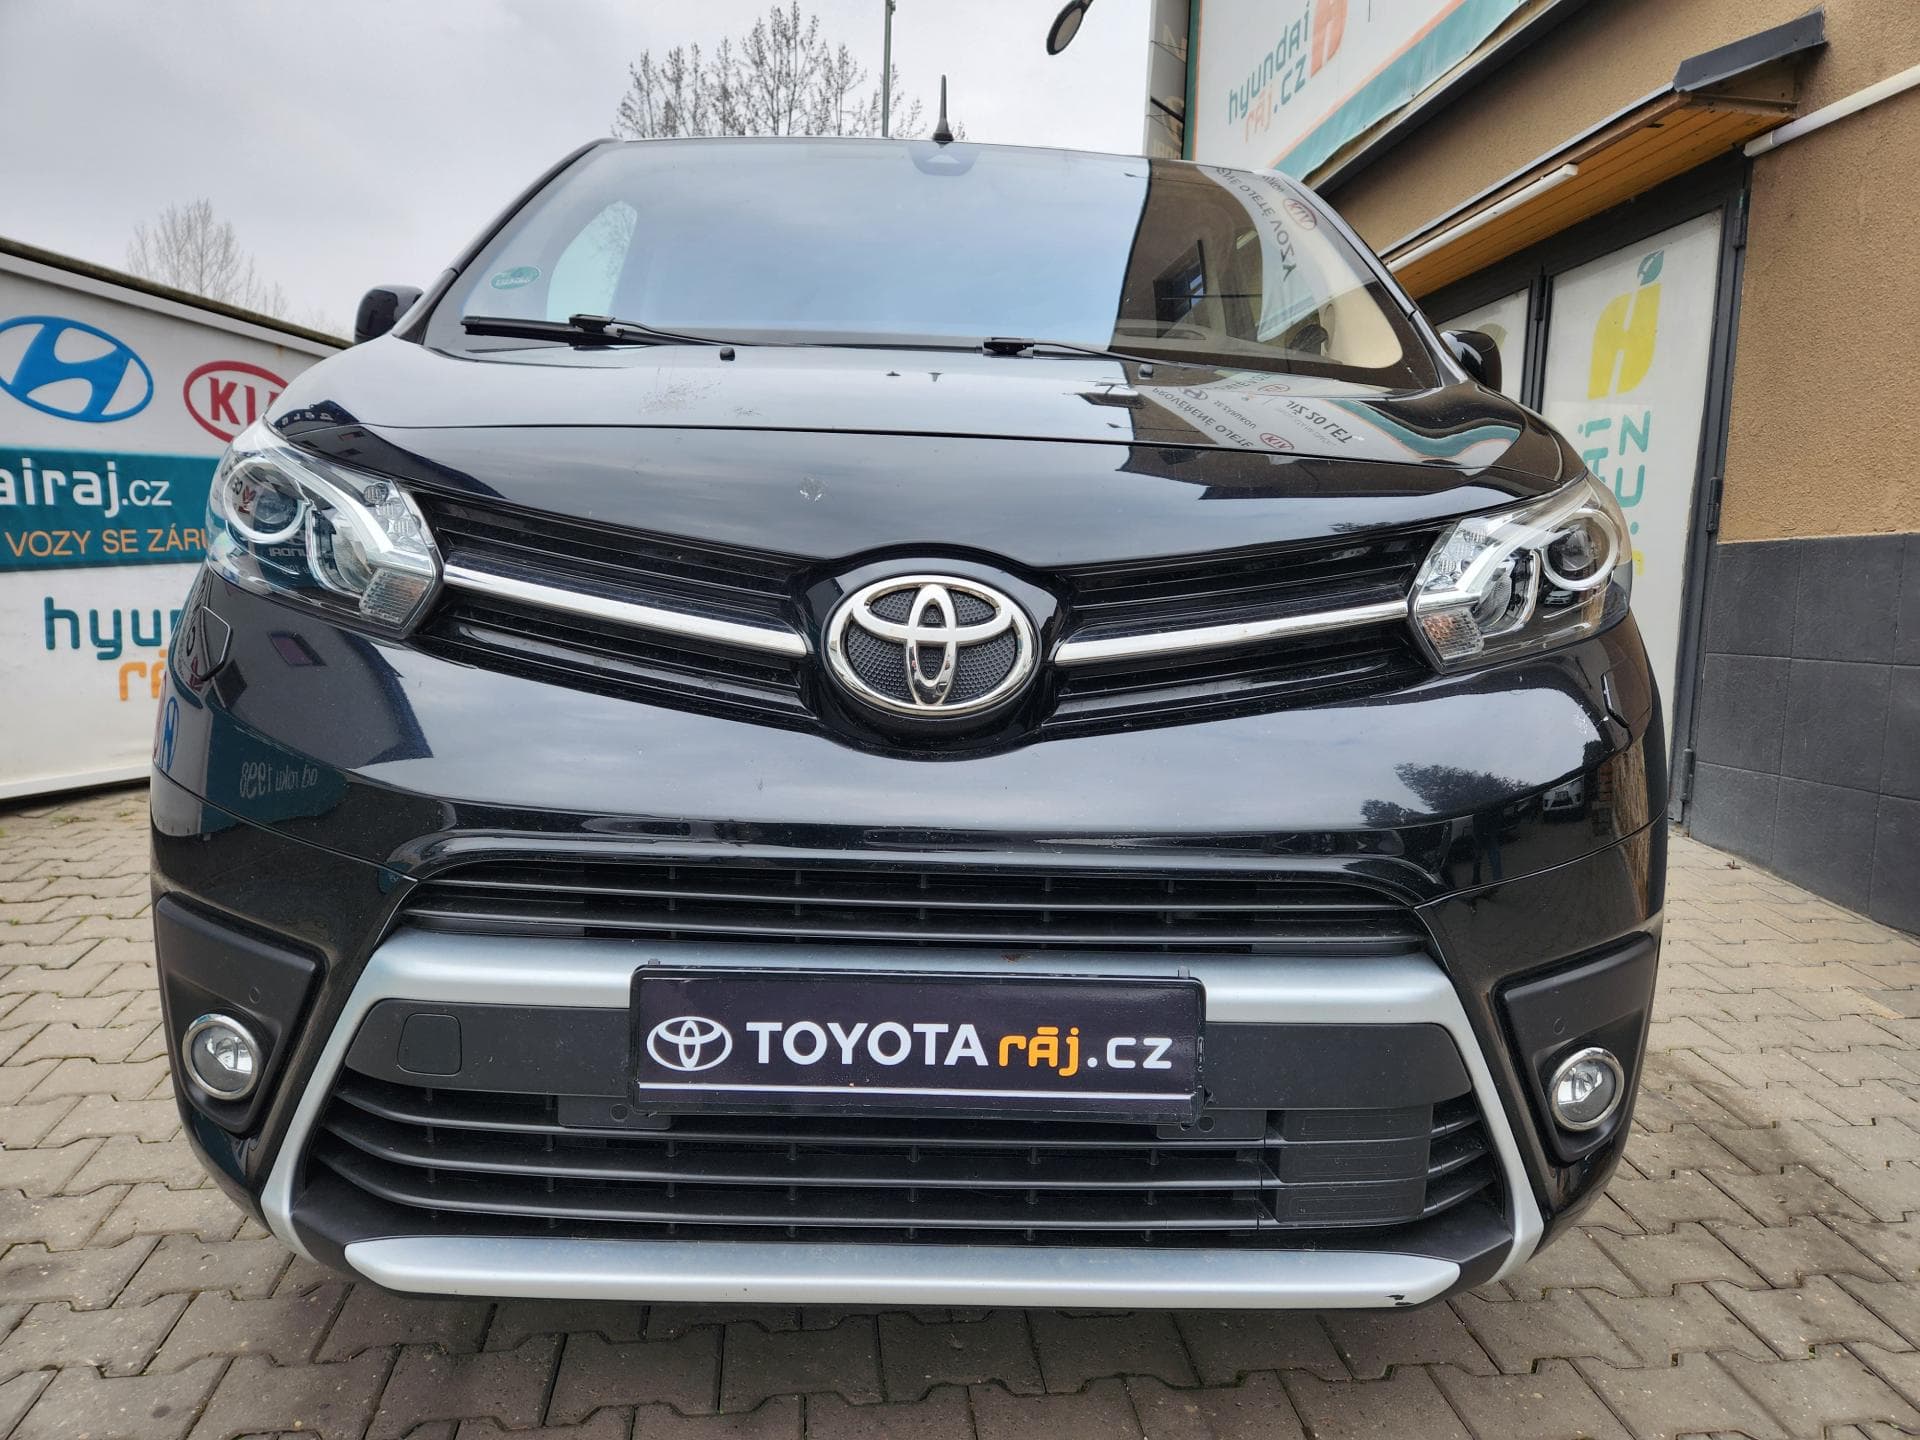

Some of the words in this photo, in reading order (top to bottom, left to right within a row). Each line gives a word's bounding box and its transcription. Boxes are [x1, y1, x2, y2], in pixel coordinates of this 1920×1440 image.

[5, 530, 91, 557] VOZY
[102, 528, 139, 554] SE
[746, 1021, 989, 1066] TOYOTA
